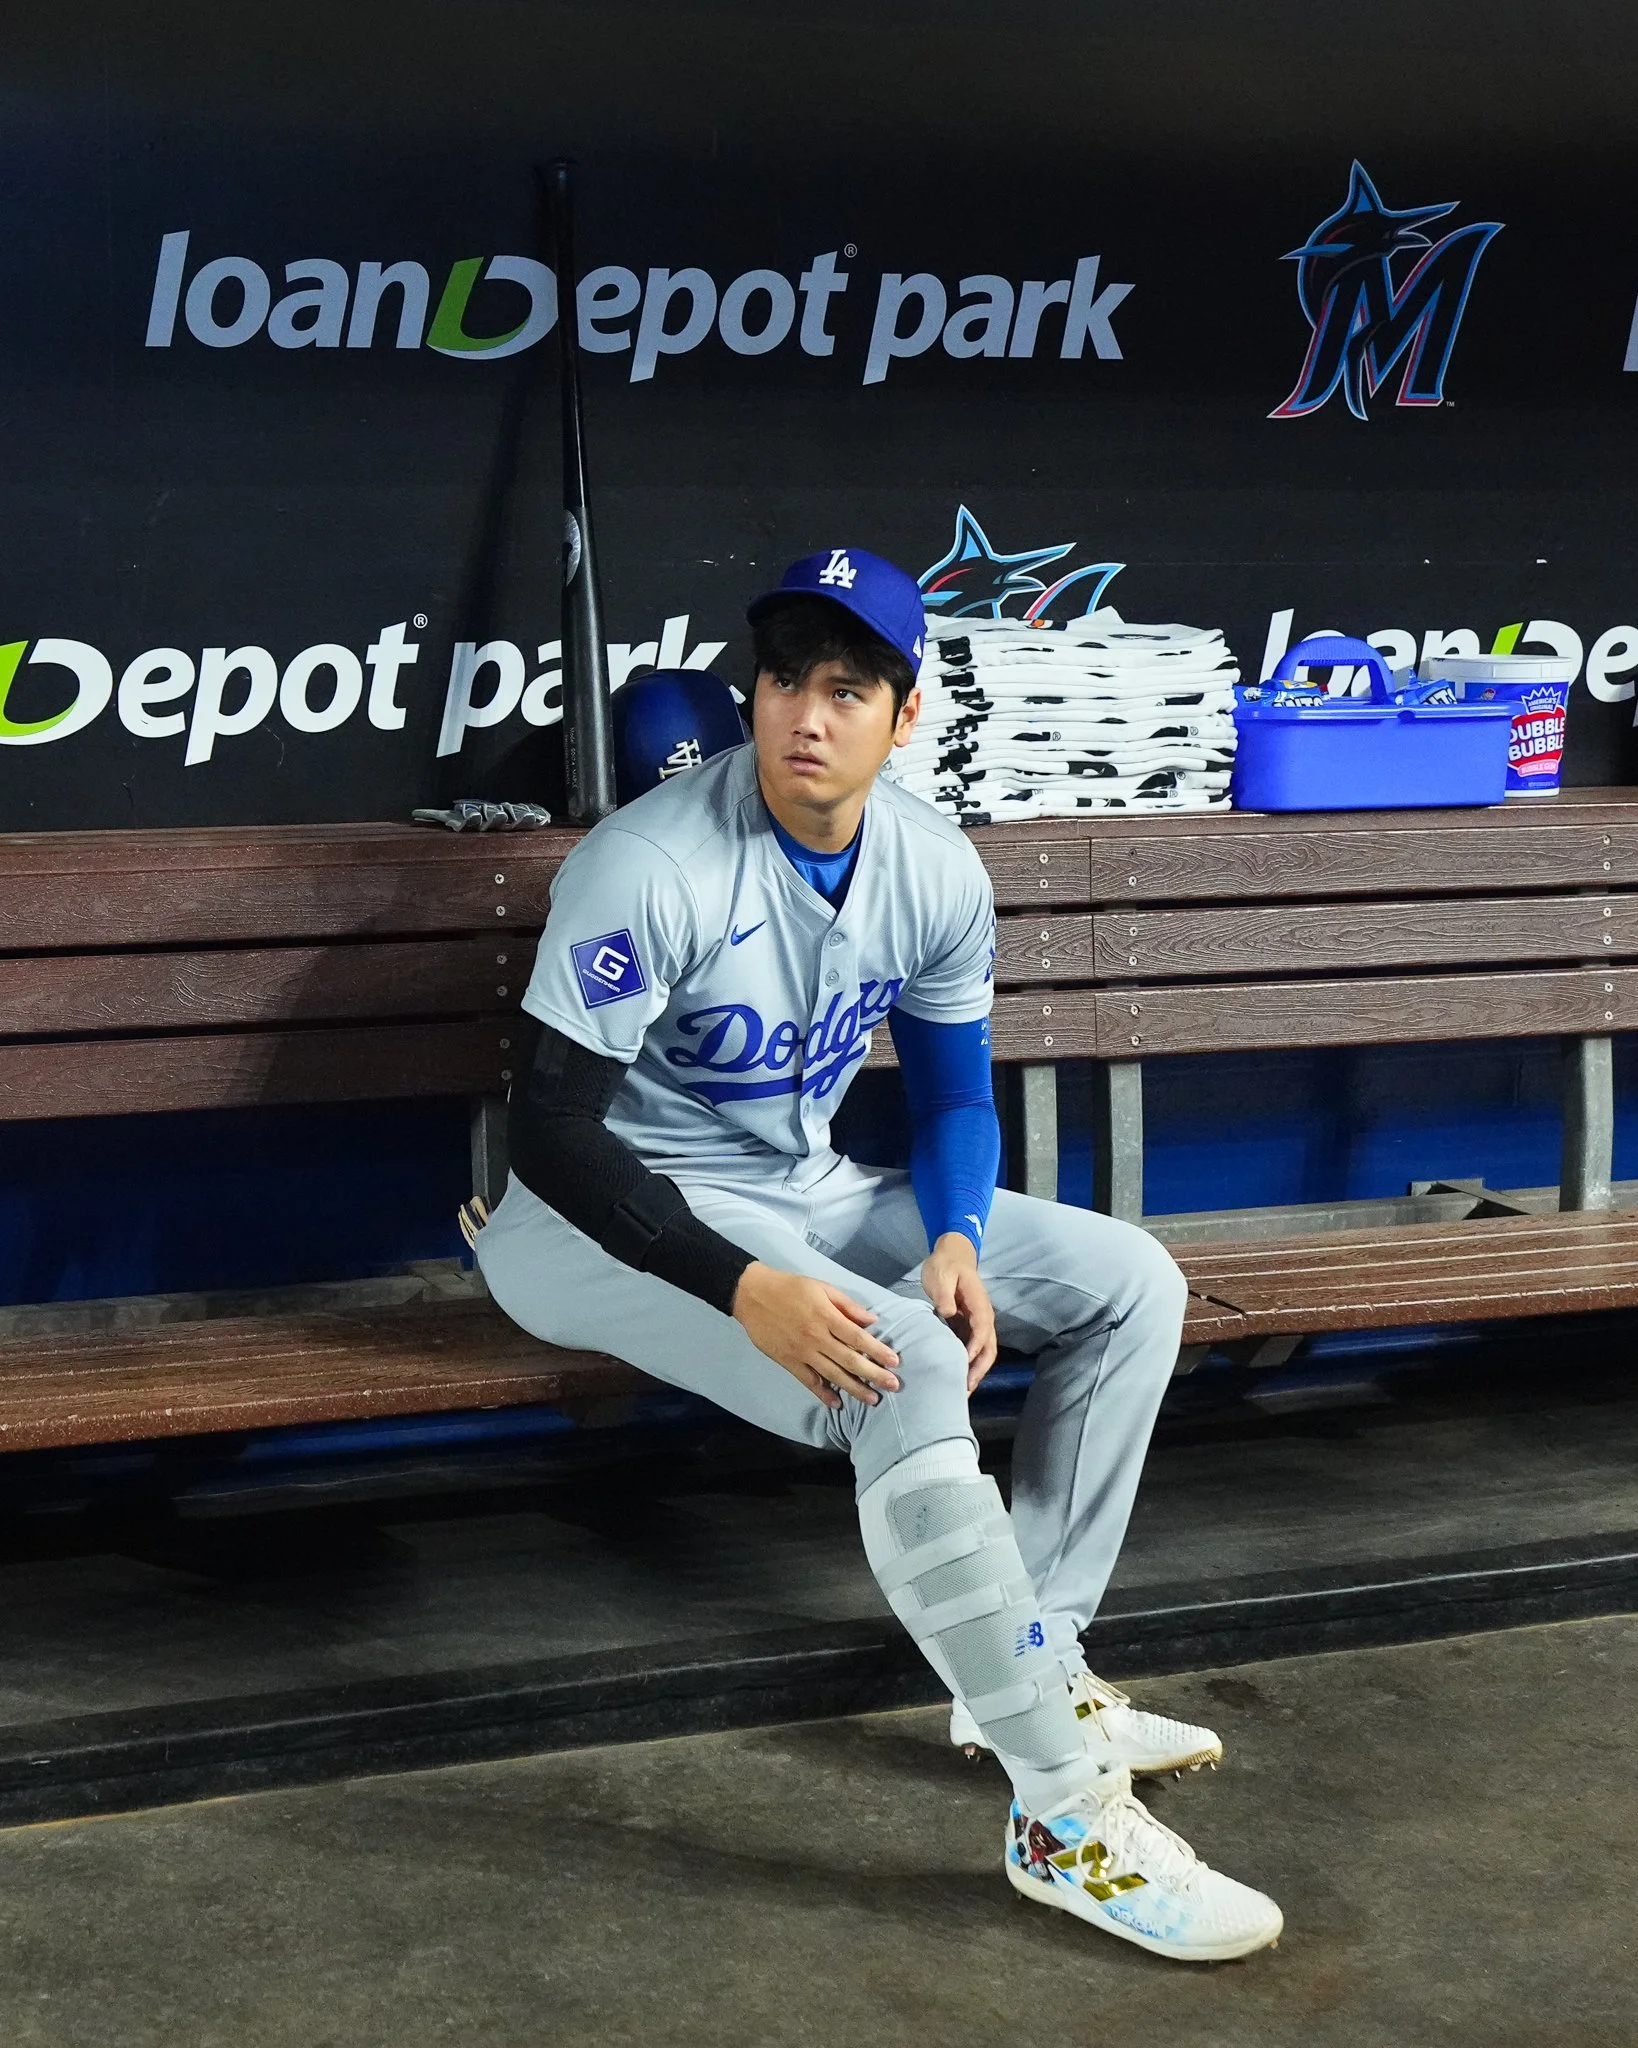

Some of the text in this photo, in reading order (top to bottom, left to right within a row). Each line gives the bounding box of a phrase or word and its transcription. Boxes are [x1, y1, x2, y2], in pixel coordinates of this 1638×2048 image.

[863, 255, 1137, 386] park
[818, 549, 858, 590] LA
[1508, 733, 1564, 761] BUBBLE
[582, 968, 621, 993] GUGGENHEIM
[592, 945, 630, 981] G
